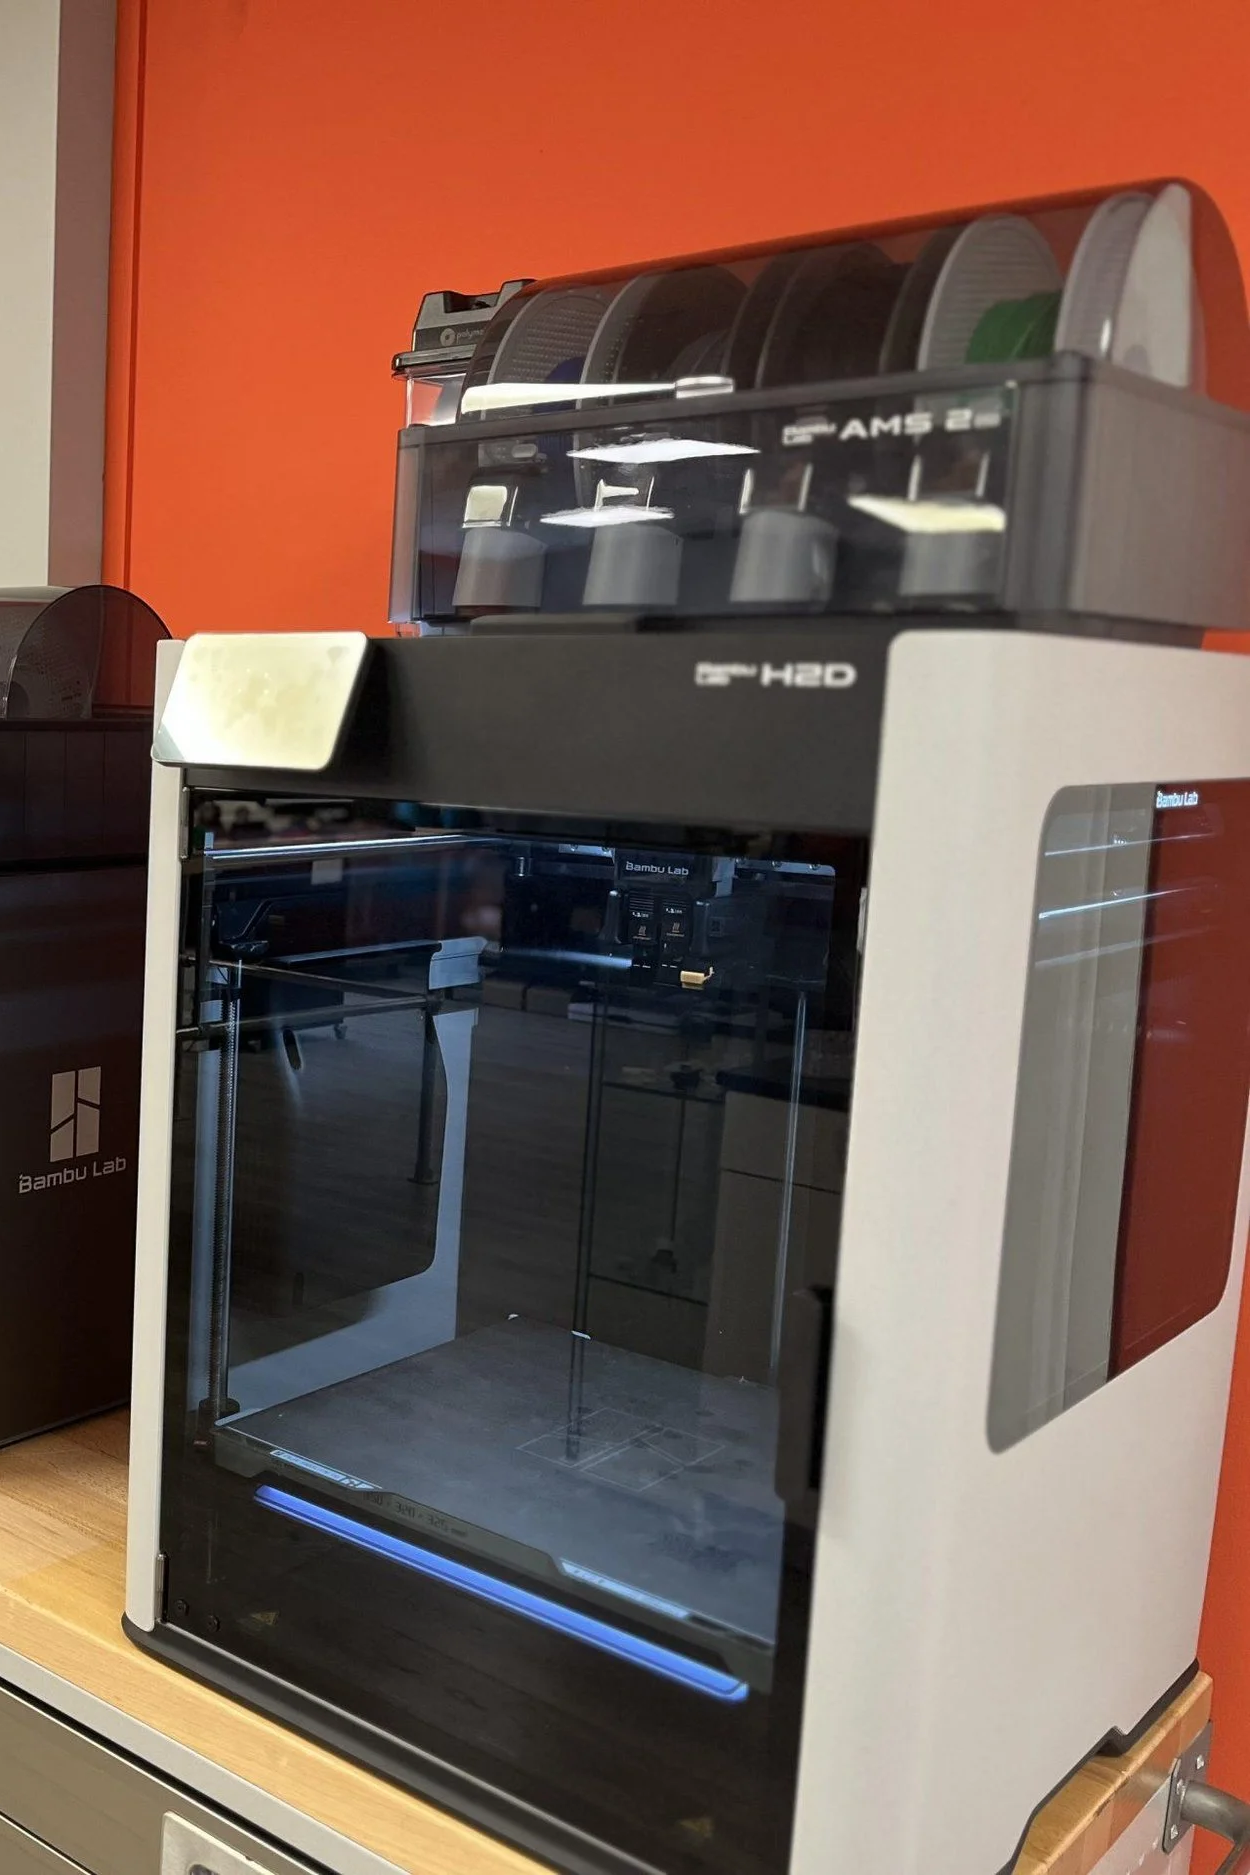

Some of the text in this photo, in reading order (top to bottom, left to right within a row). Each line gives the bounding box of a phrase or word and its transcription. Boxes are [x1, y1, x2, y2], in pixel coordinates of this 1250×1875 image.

[839, 414, 932, 440] AMS
[760, 662, 857, 687] H2D
[1156, 790, 1198, 809] Bambu Lab
[626, 861, 689, 875] Bambu Lab
[18, 1156, 128, 1194] Bambu Lab
